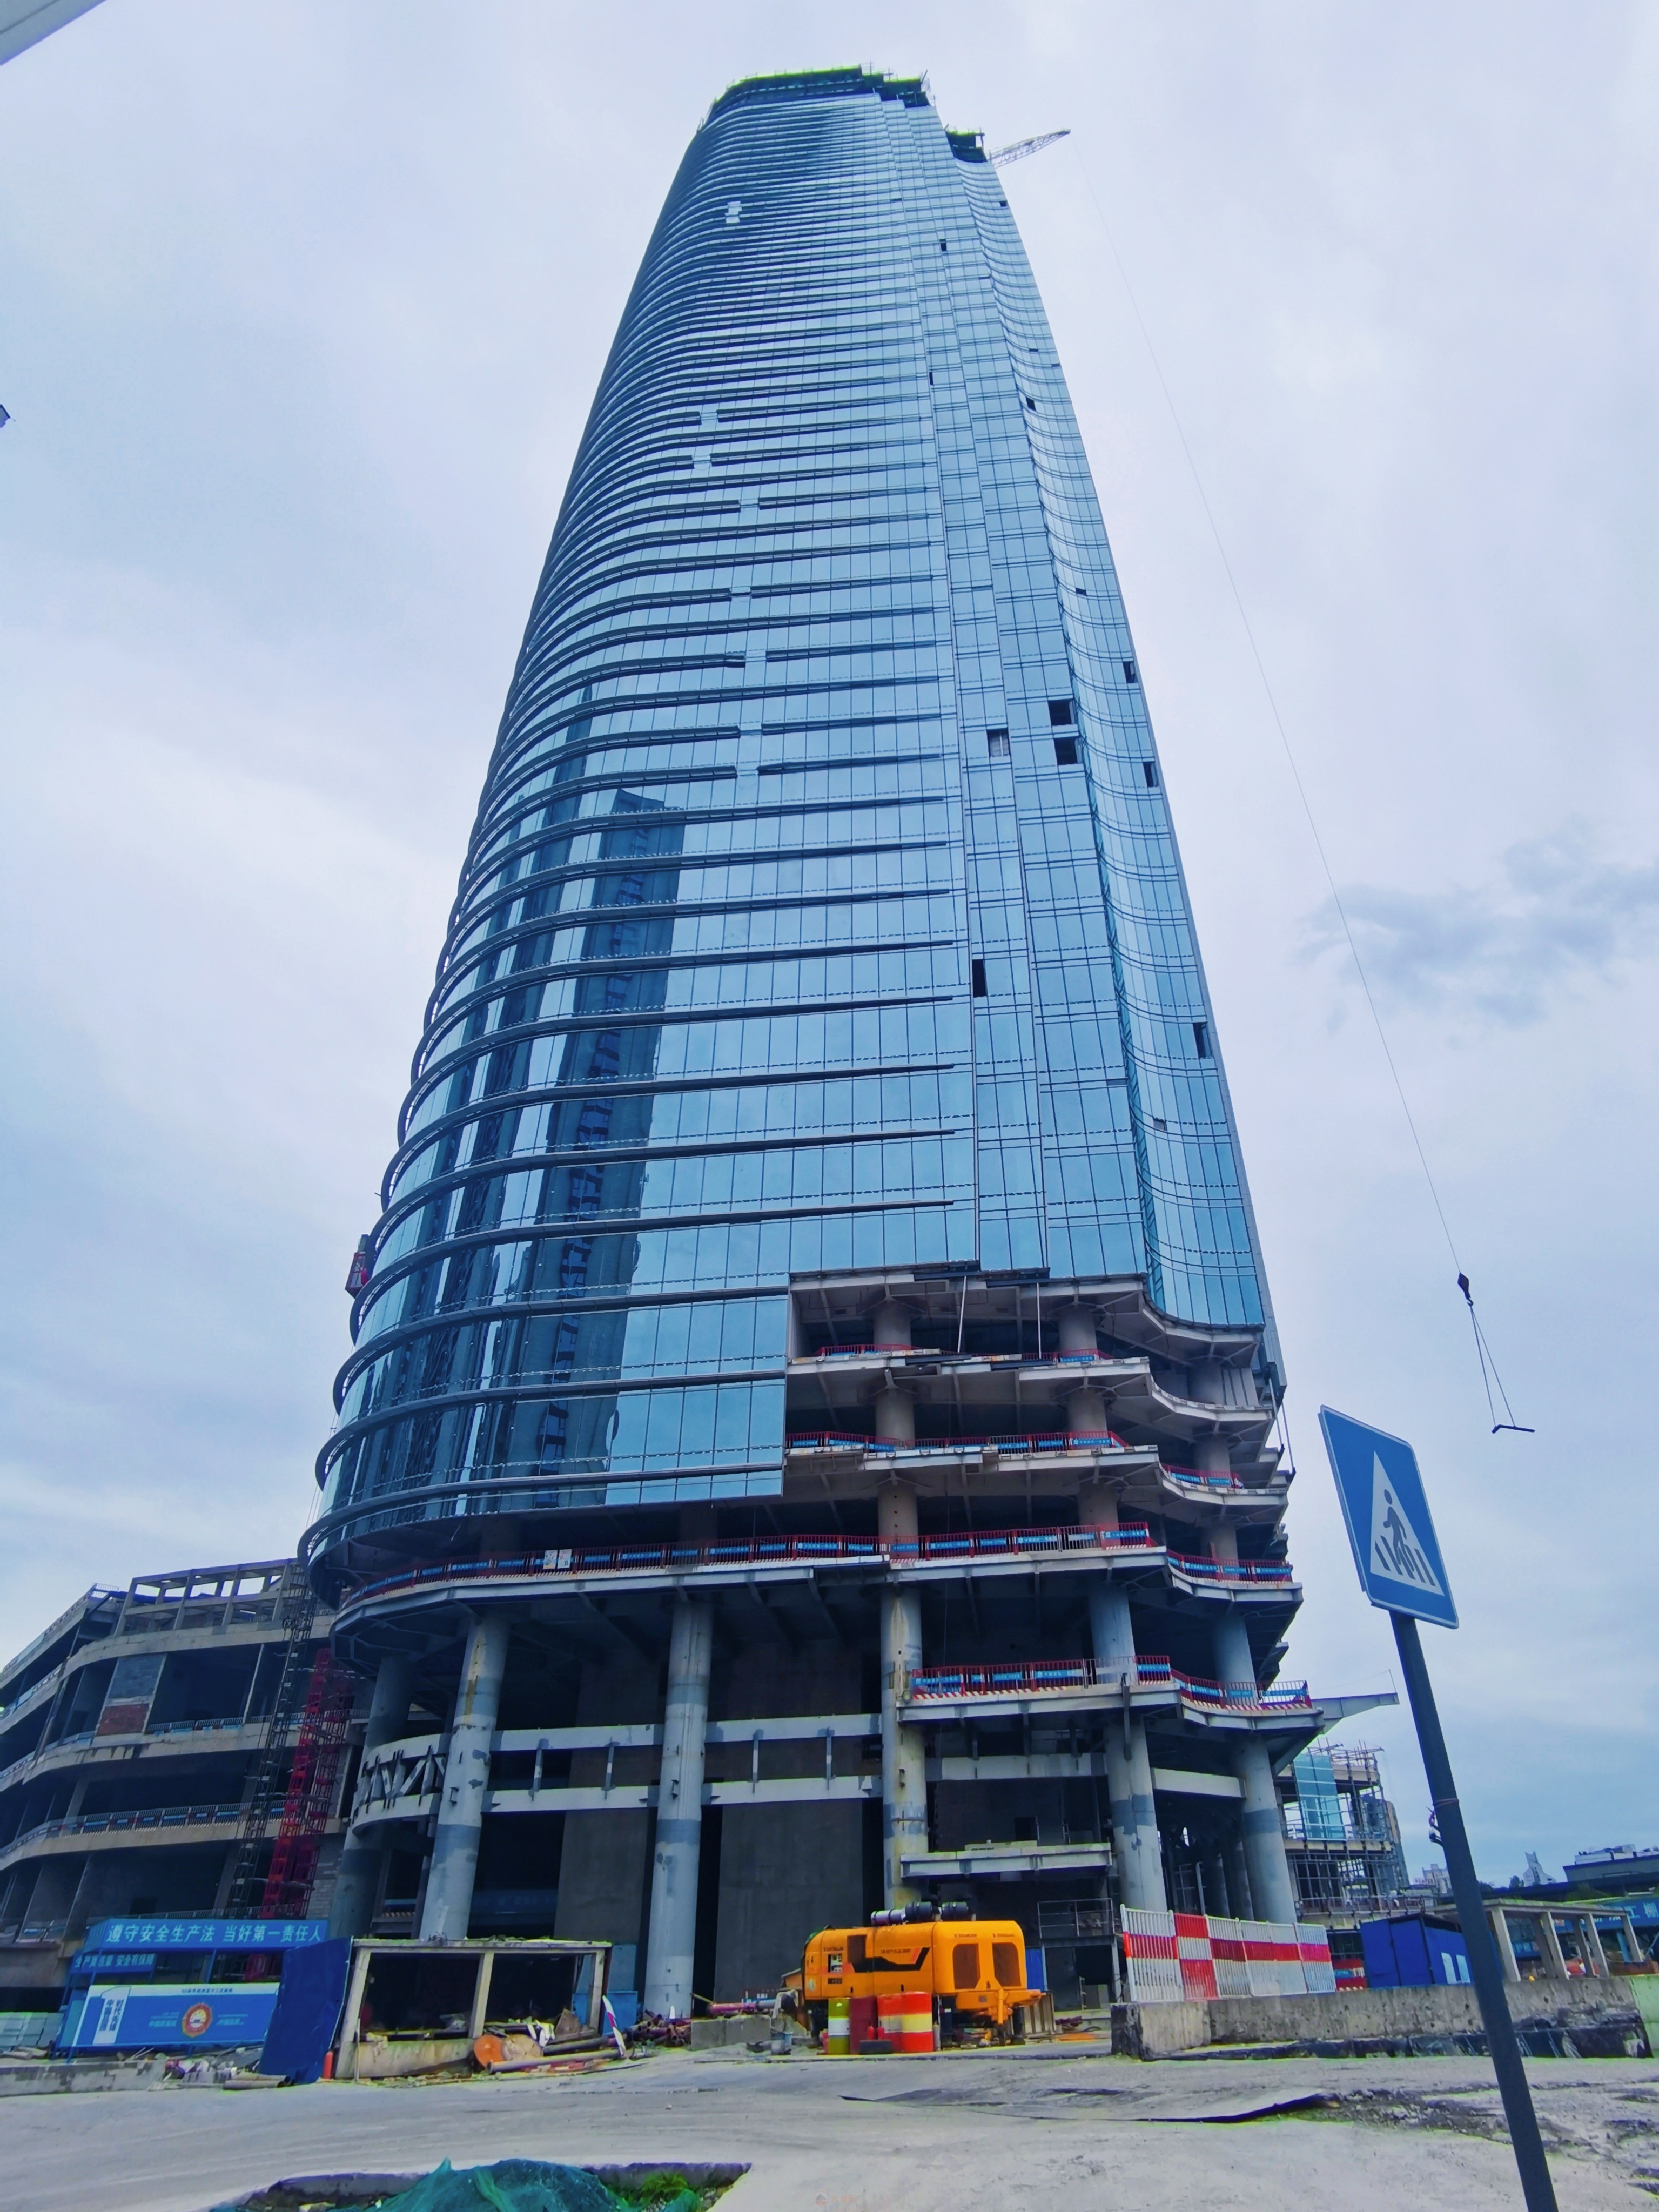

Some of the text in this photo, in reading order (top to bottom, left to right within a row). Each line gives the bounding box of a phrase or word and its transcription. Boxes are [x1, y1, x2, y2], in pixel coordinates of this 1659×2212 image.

[106, 1923, 321, 1943] 遵守安全生产法 当好第一责任人
